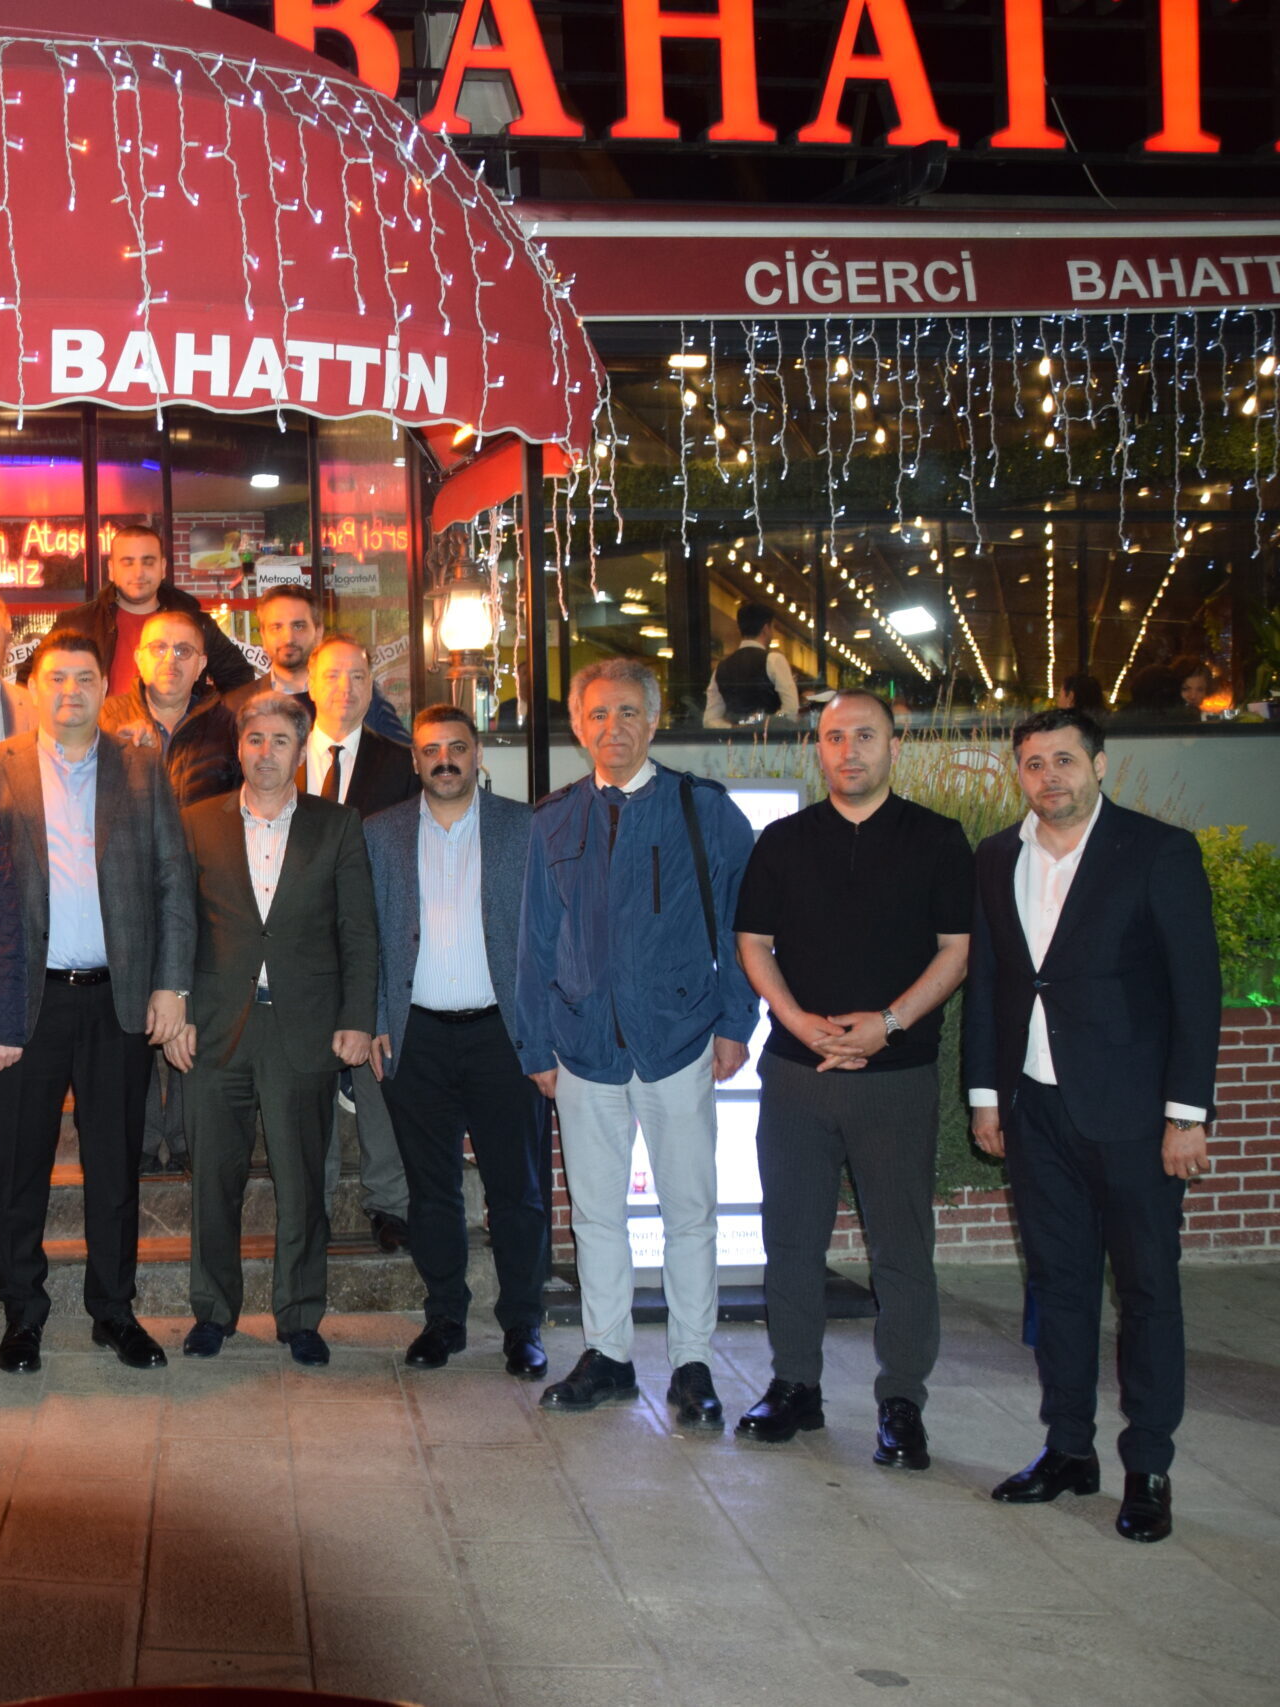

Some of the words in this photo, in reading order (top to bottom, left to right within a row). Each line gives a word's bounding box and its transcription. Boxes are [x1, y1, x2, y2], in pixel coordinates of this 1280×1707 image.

[744, 250, 977, 306] CİĞERCİ
[1066, 255, 1280, 301] BAHATT
[51, 329, 448, 415] BAHATTİN
[258, 574, 302, 586] Metropol
